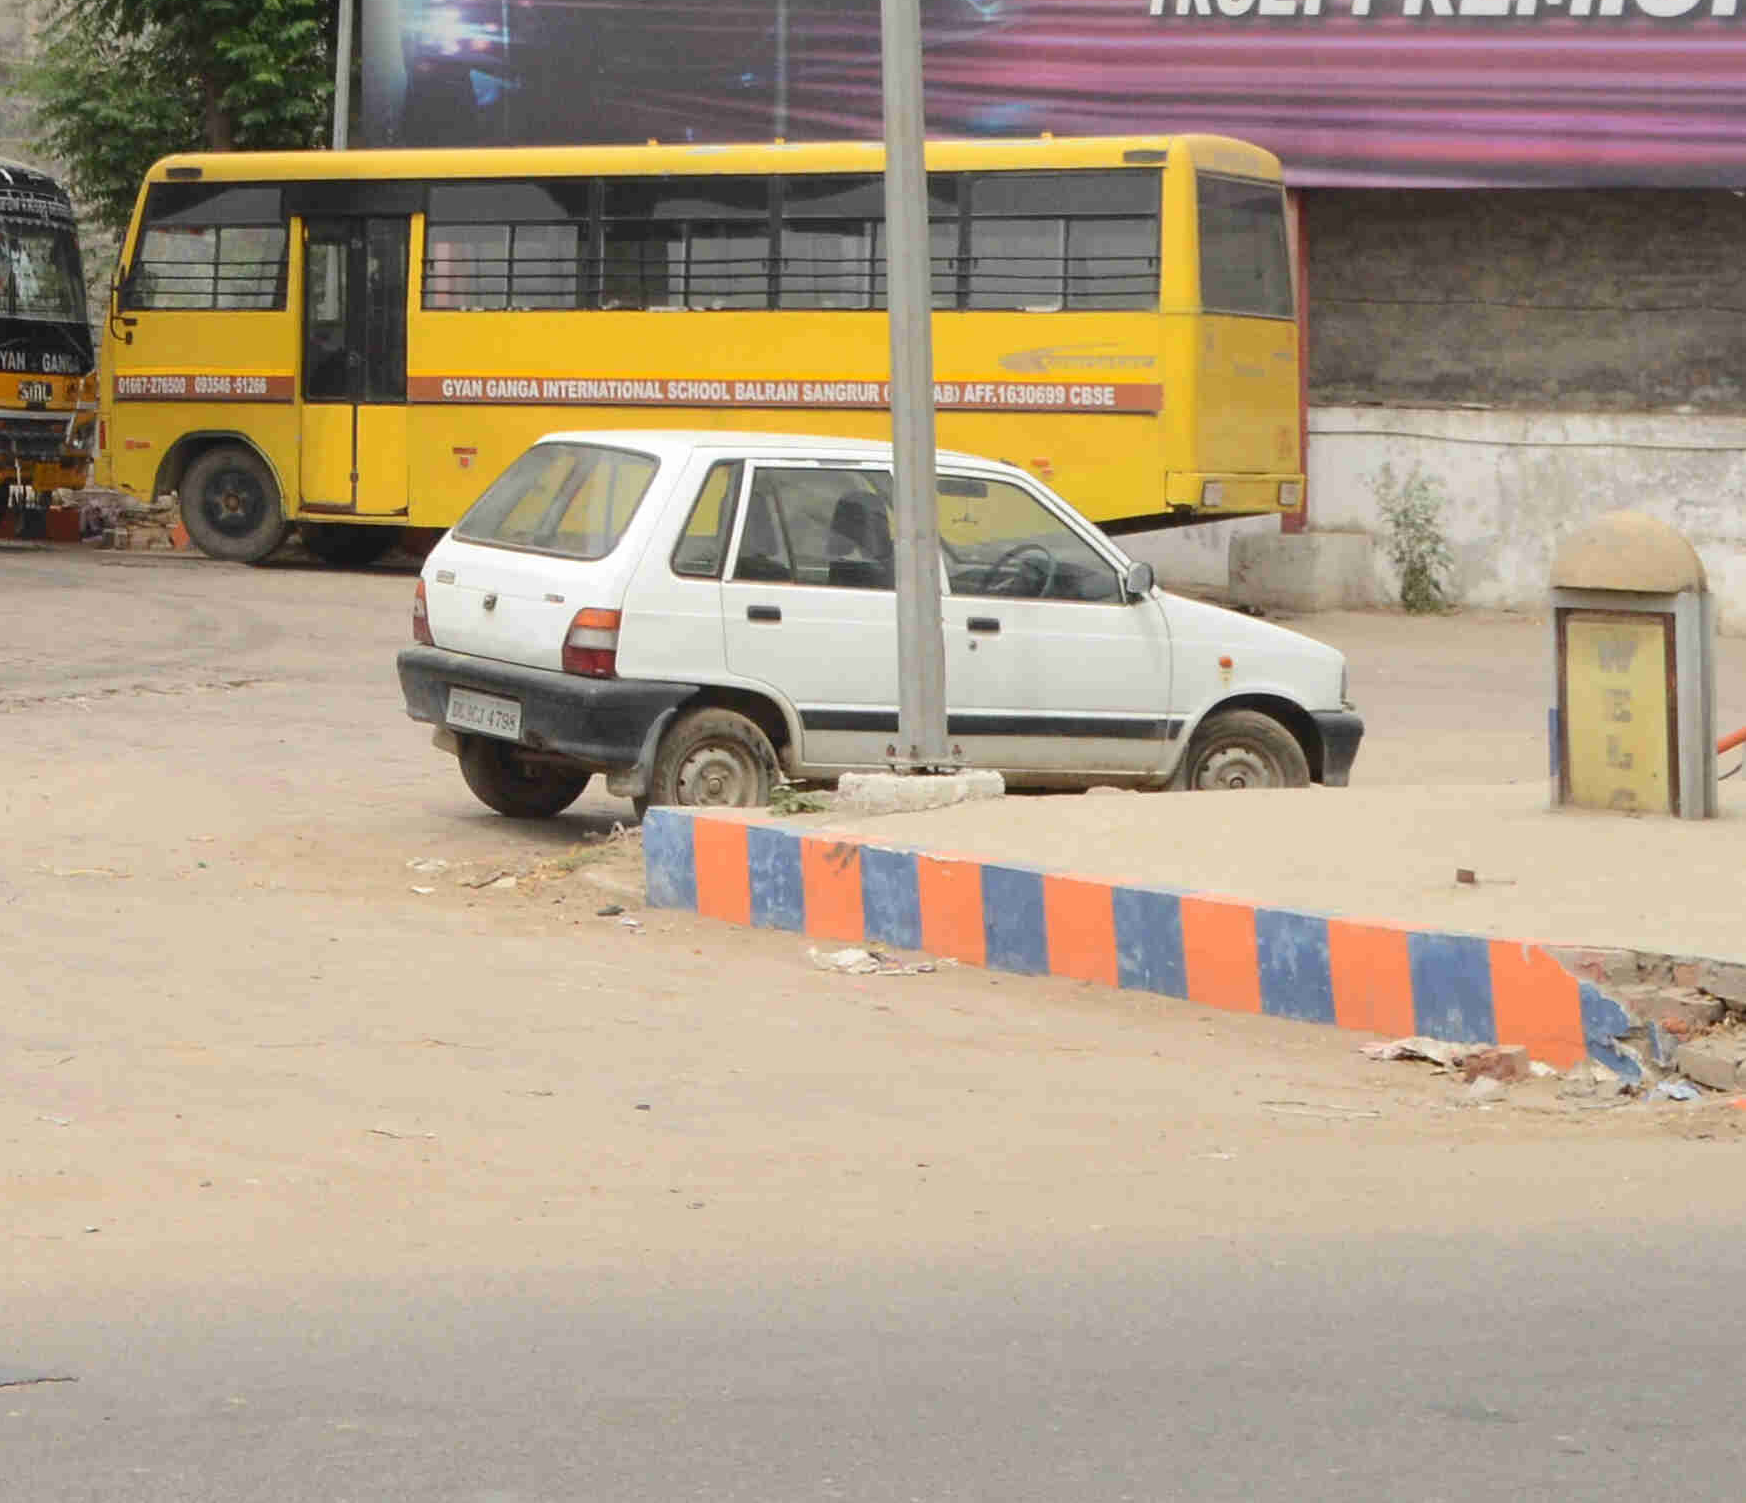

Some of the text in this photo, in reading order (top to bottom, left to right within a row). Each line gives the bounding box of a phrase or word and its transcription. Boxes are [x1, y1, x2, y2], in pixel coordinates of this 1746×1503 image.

[442, 379, 483, 397] GYAN
[486, 379, 540, 398] GANGA
[543, 380, 663, 399] INTERNATIONAL
[667, 381, 730, 399] SCHOOL
[735, 382, 798, 401] BALRAN
[803, 383, 880, 402] SANGRUR
[1069, 386, 1116, 405] CBSE
